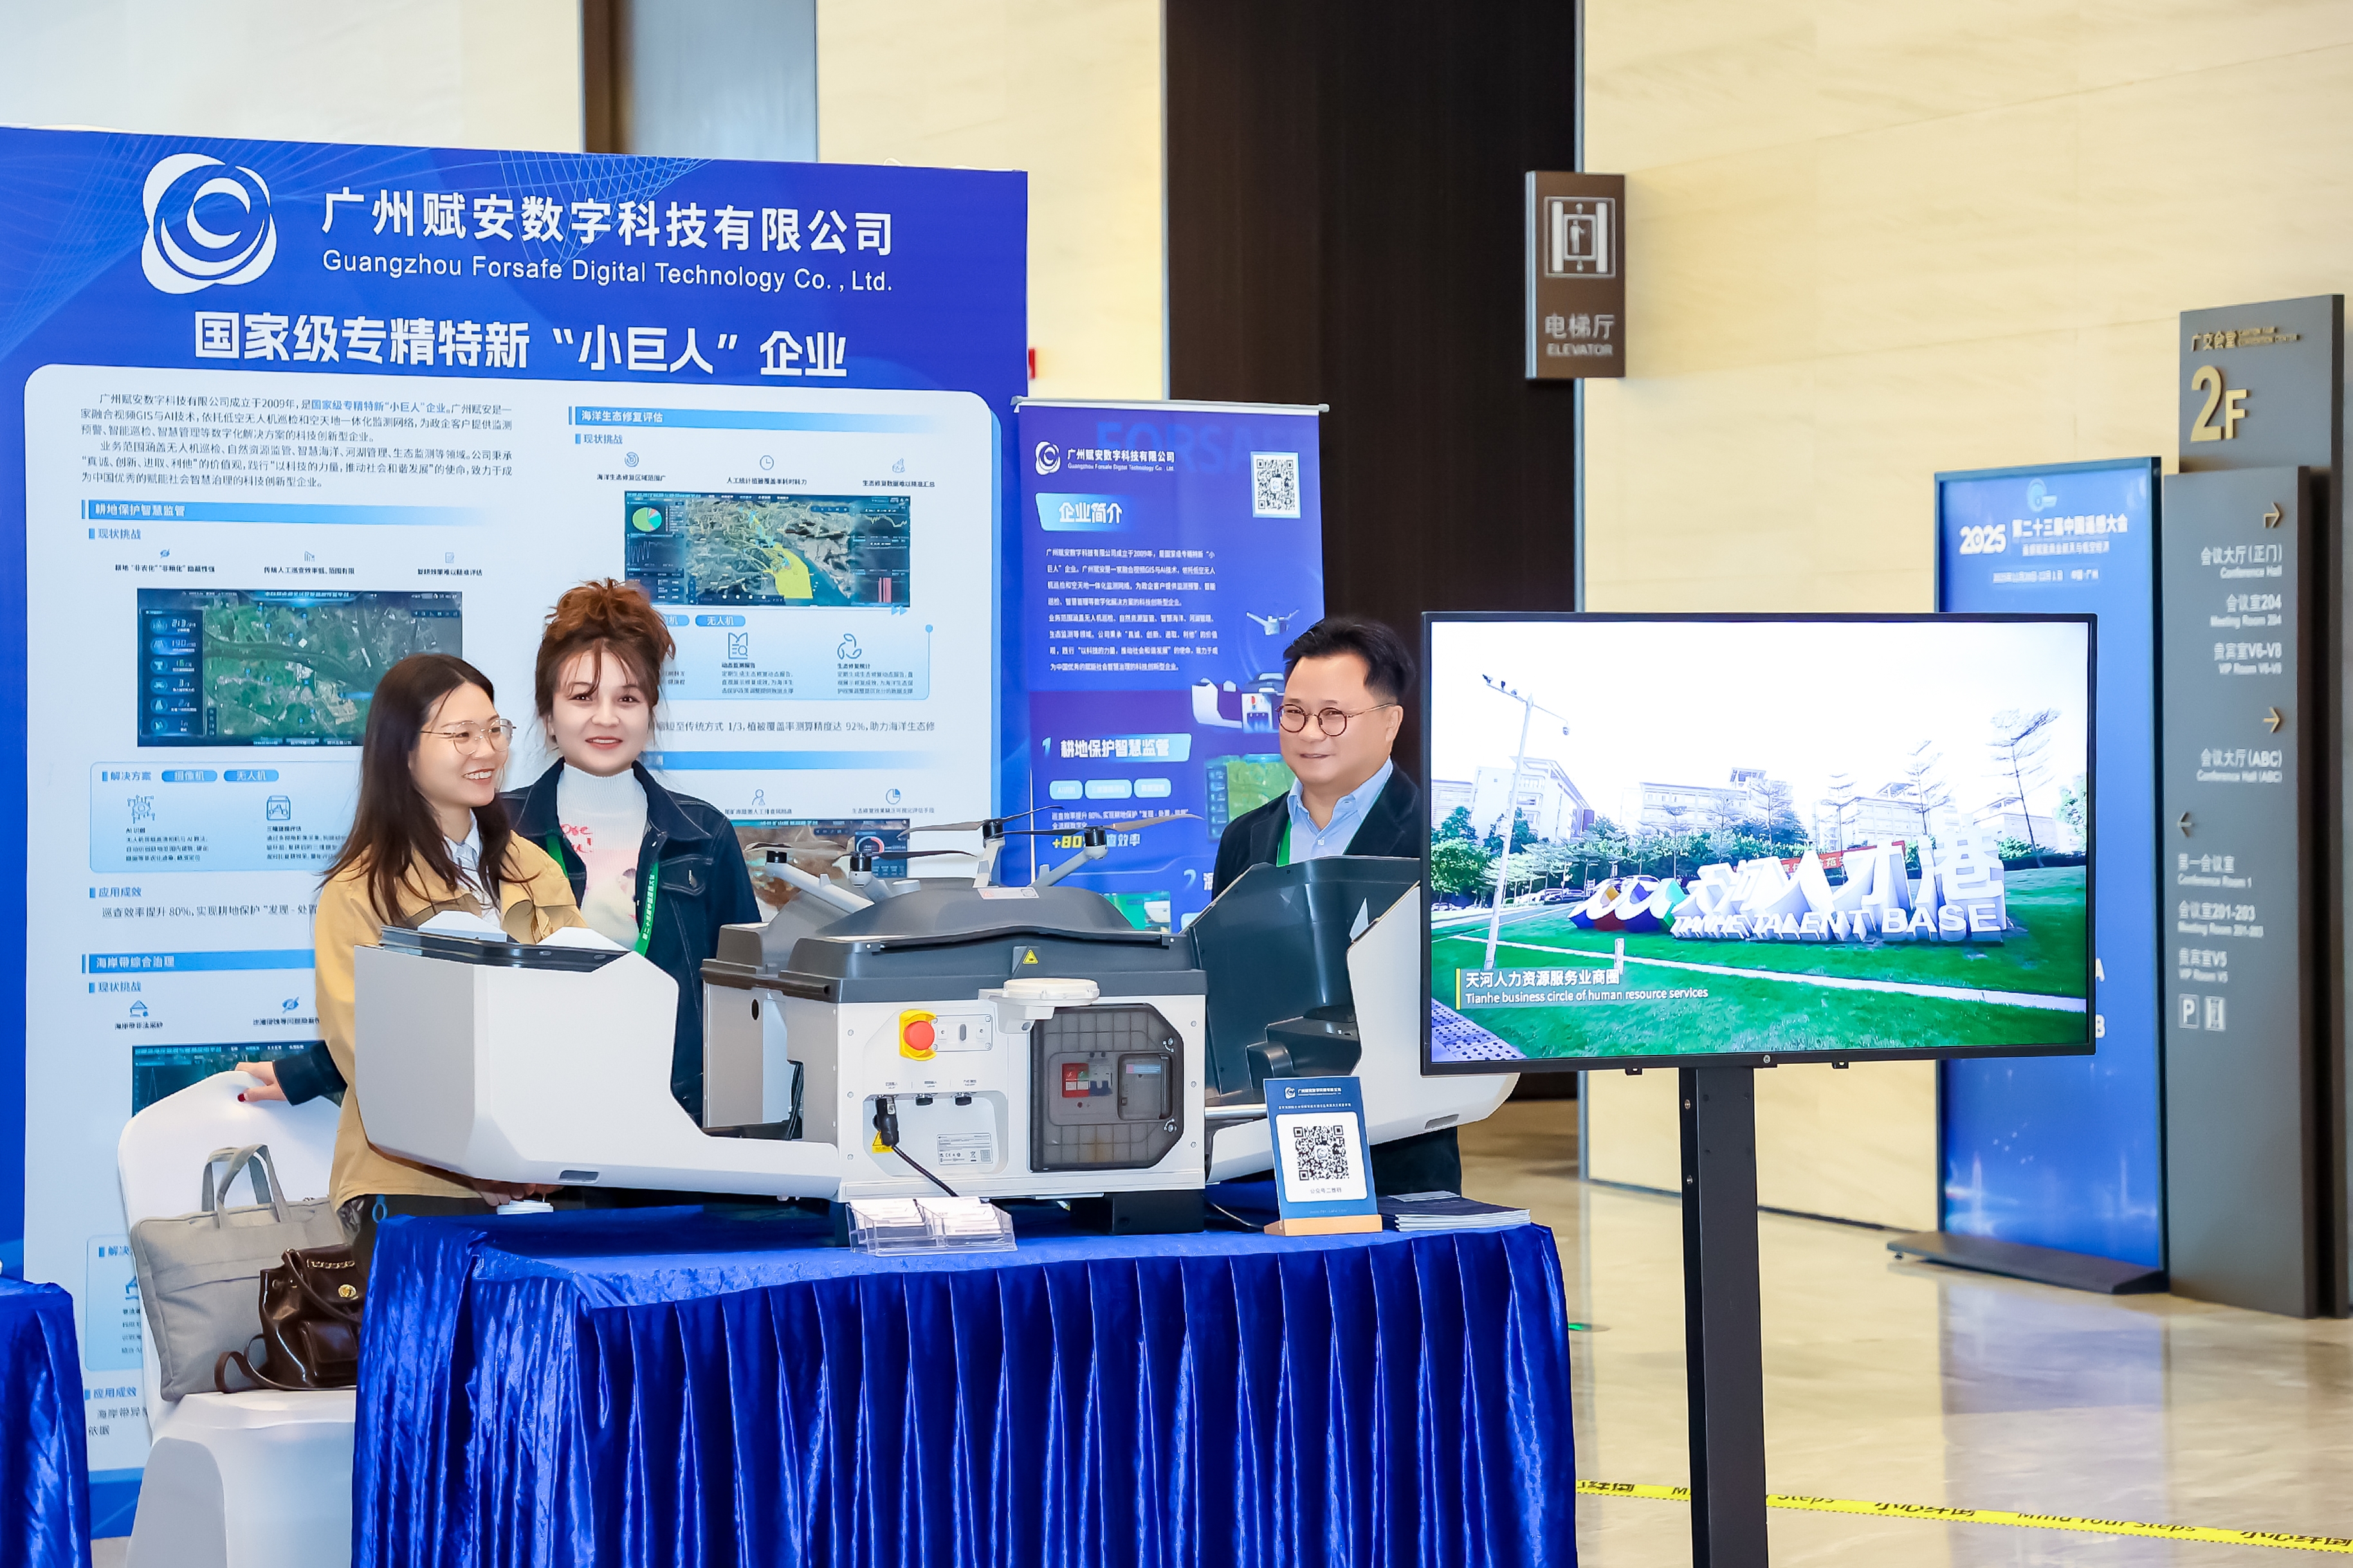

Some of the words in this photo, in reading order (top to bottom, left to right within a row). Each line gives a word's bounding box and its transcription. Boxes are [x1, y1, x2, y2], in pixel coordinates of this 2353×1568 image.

[322, 187, 892, 256] 广州赋安数字科技有限公司
[322, 250, 462, 279] Guangzhou
[473, 254, 562, 280] Forsafe
[572, 259, 646, 286] Digital
[654, 262, 785, 293] Technology
[852, 270, 893, 291] Ltd.
[1545, 313, 1615, 340] 电梯厅
[1546, 343, 1613, 356] ELEVATOR
[2190, 365, 2248, 442] 2F
[581, 410, 663, 423] 海洋生态修复评估
[583, 433, 623, 444] 现状挑战
[1067, 448, 1175, 462] 广州赋安数字科技有限公司
[95, 503, 185, 517] 耕地保护智慧监管
[1058, 502, 1122, 524] 企业简介
[98, 528, 141, 540] 现状挑战
[1959, 524, 2006, 554] 2025
[707, 615, 734, 626] 无人机
[1061, 738, 1170, 758] 耕地保护智慧监管
[1052, 835, 1084, 848] +80
[98, 887, 142, 898] 应用成效
[1751, 908, 1869, 937] TALENT
[1881, 903, 2001, 934] BASE
[1465, 969, 1620, 989] 天河人力资源服务业商圈
[98, 981, 142, 992] 现状挑战
[1465, 992, 1501, 1005] Tianhe
[1501, 991, 1546, 1003] business
[1546, 990, 1574, 1002] circle
[1575, 989, 1588, 1001] of
[1588, 989, 1622, 1001] human
[1625, 990, 1669, 1000] resource
[1669, 987, 1709, 999] services
[1671, 1487, 1691, 1495] M
